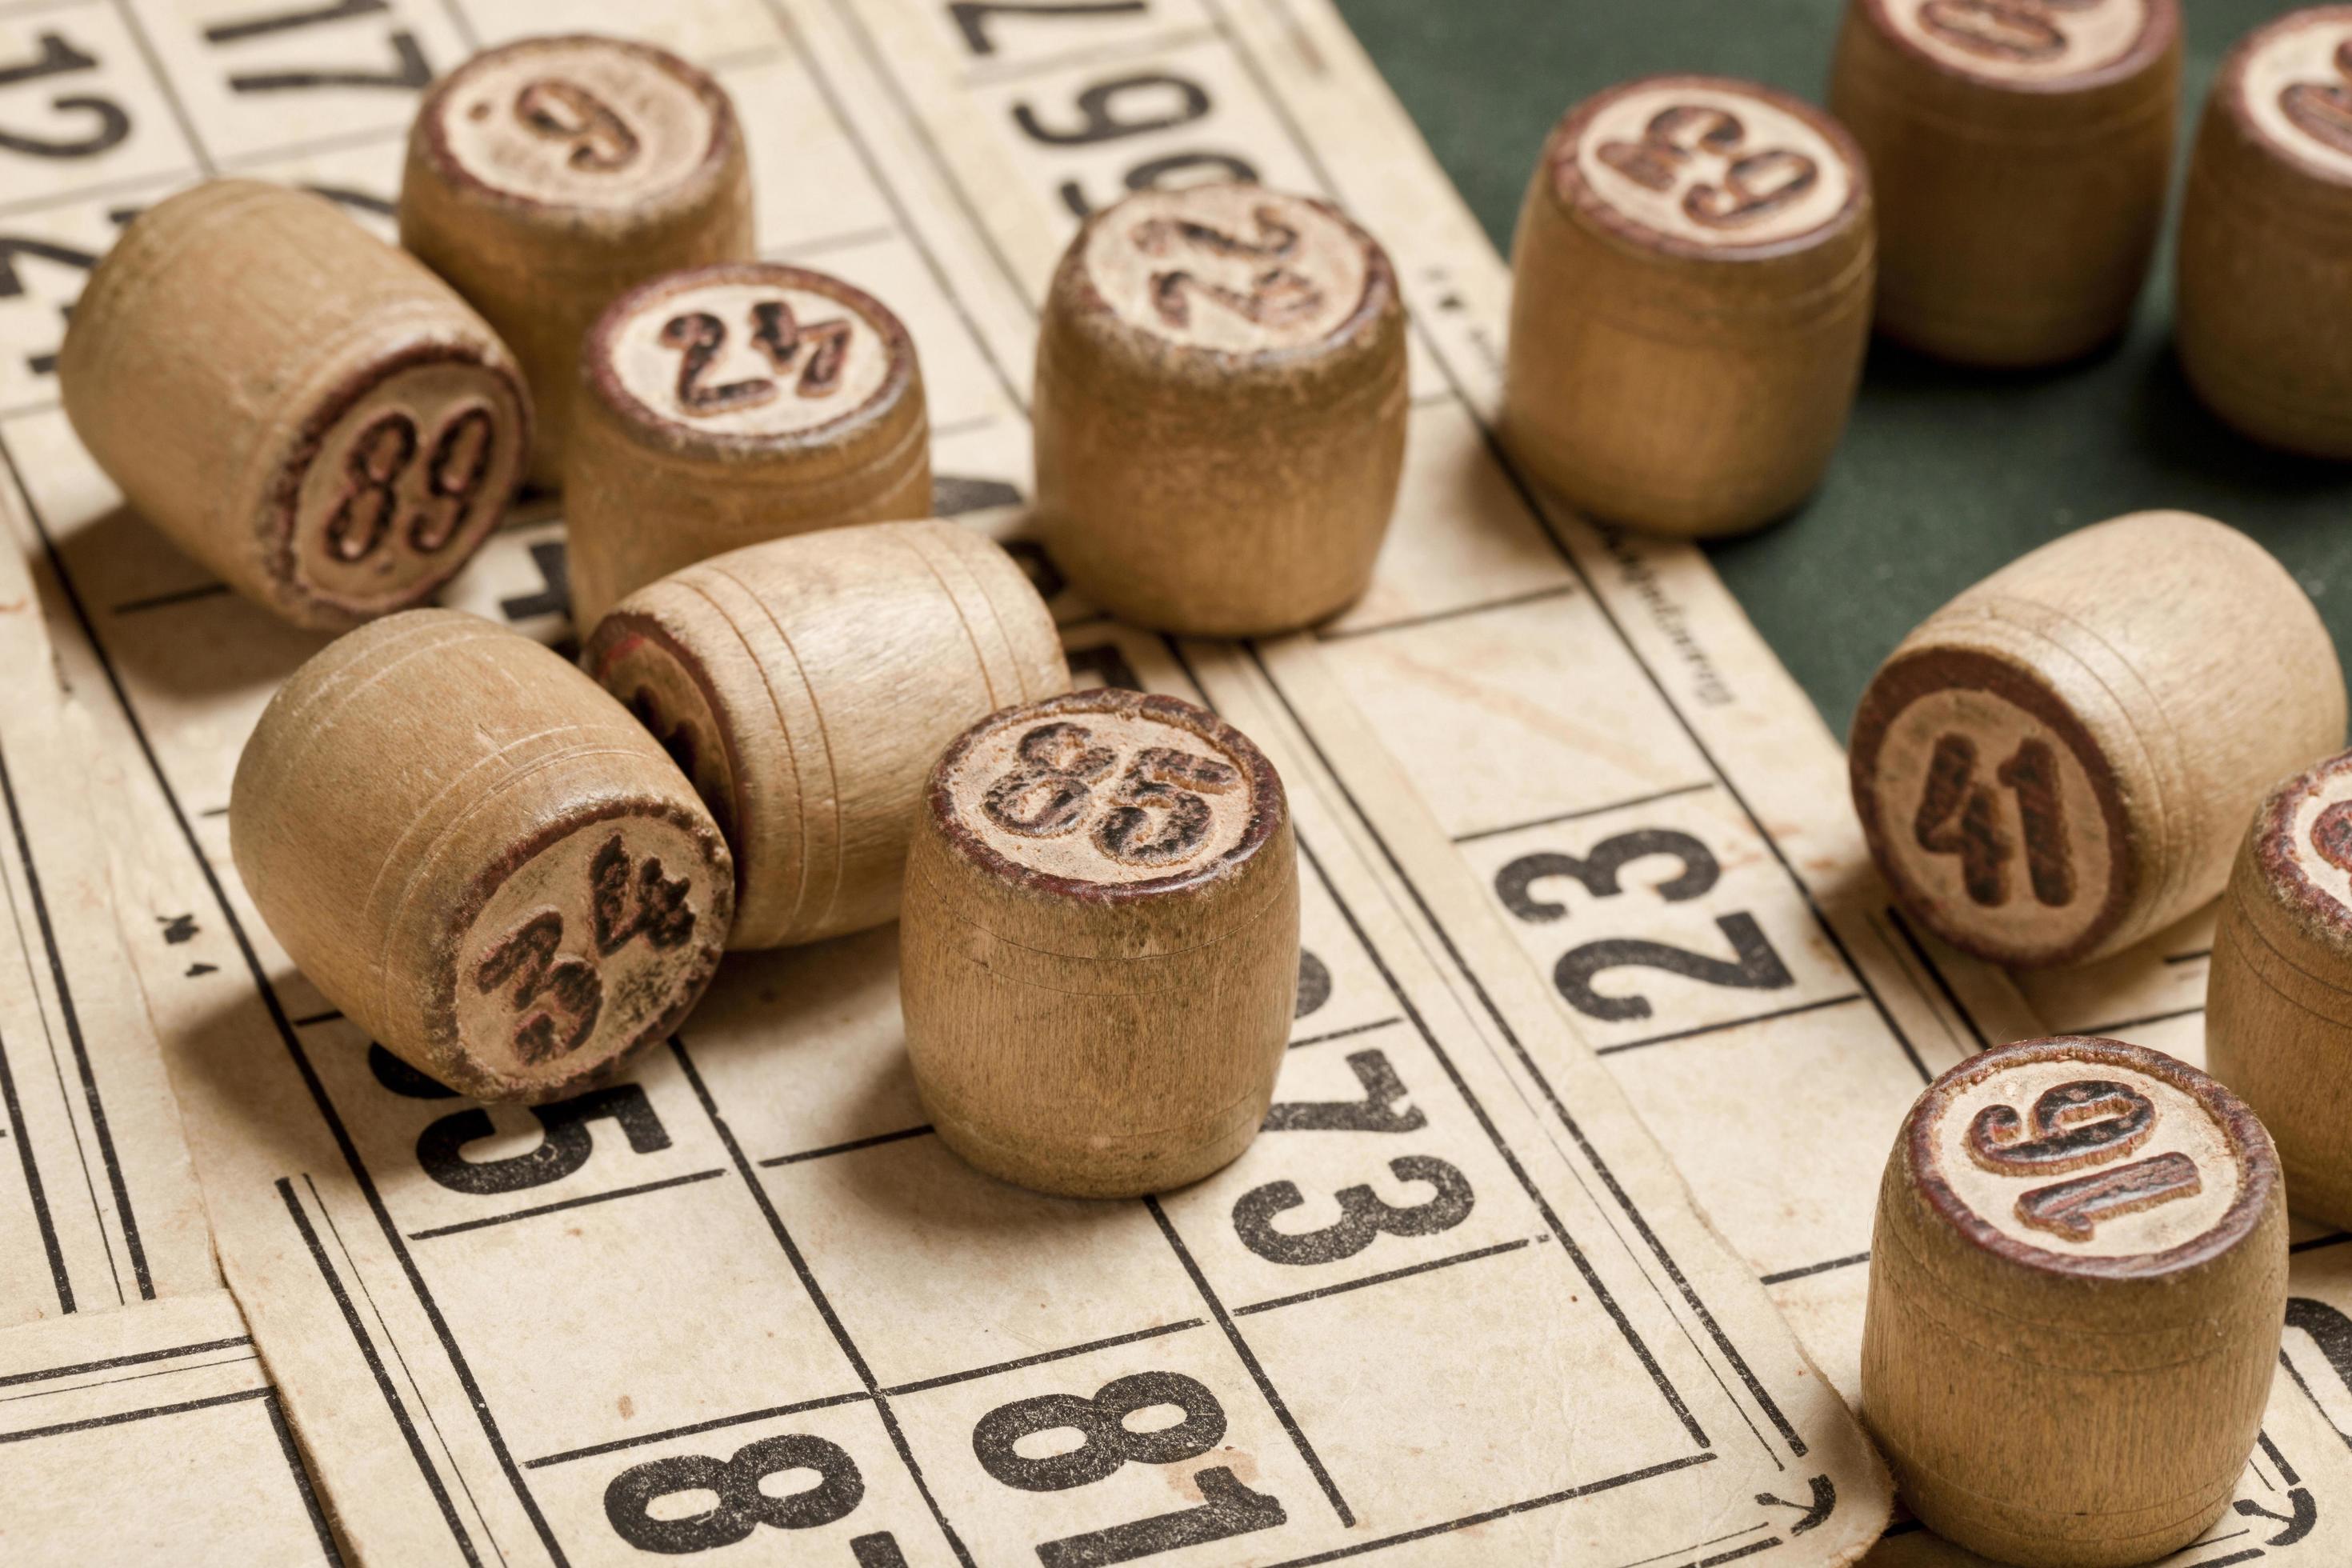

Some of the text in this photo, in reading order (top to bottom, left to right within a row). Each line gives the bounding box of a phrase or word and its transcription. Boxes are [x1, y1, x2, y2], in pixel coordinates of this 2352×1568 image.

[325, 406, 494, 563] 89
[1914, 731, 2078, 908] 41
[475, 831, 698, 1069] 34
[1494, 828, 1795, 1022] 23
[369, 1039, 672, 1195] 5
[1231, 1048, 1475, 1266] 73
[1962, 1078, 2202, 1242] 16
[604, 1434, 910, 1568] 8
